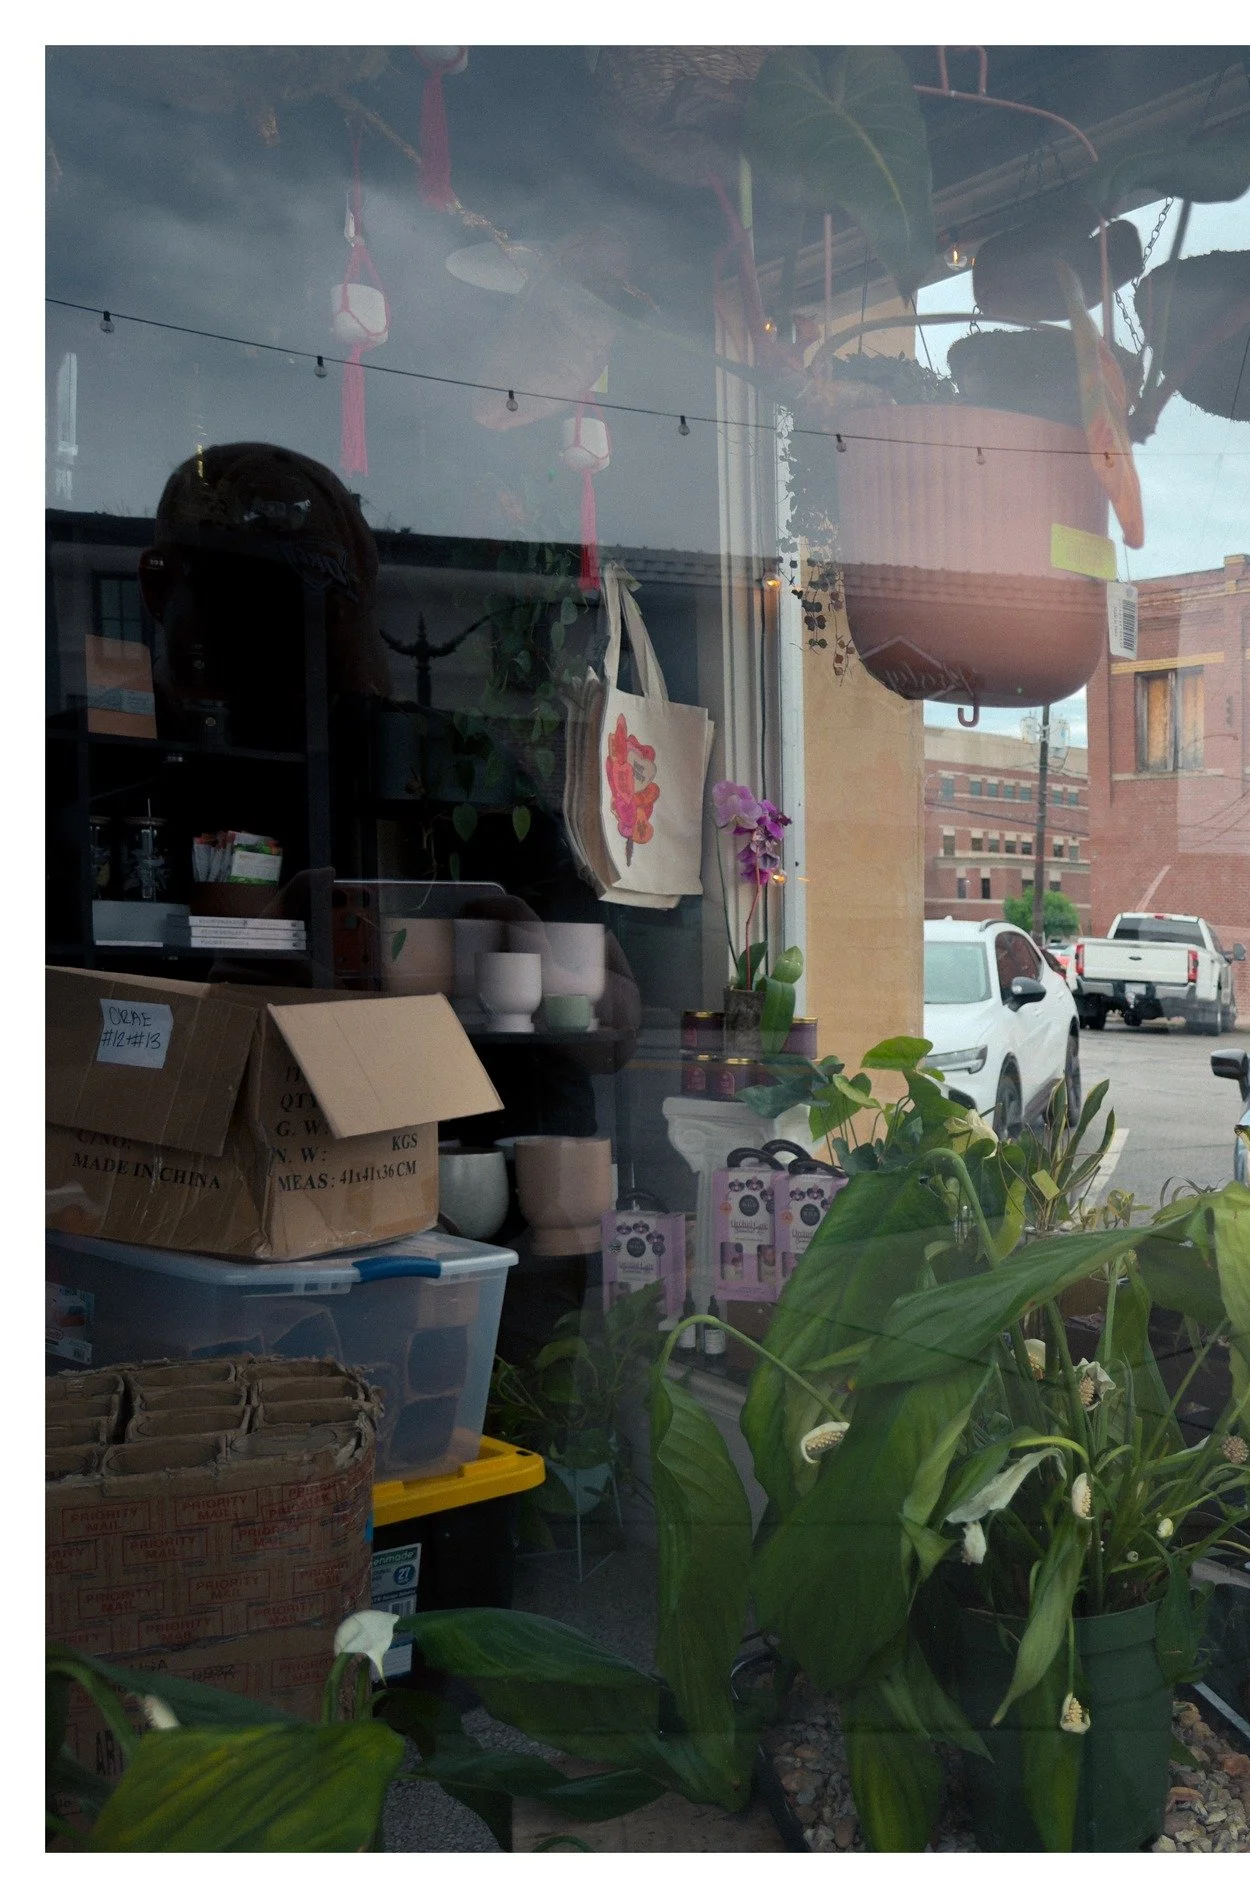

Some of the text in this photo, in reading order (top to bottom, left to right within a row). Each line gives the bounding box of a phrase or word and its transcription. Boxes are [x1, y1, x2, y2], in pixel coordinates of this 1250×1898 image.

[391, 1132, 418, 1151] KGS
[71, 1152, 221, 1190] MADE IN CHINA
[278, 1172, 336, 1192] MEAS:
[396, 1159, 417, 1176] CM
[182, 1495, 248, 1511] PRIORITY
[70, 1507, 139, 1523] PRIORITY
[197, 1509, 228, 1521] MAIL
[86, 1521, 118, 1533] MAIL
[130, 1536, 196, 1550] PRIORITY
[373, 1550, 414, 1567] enmade
[398, 1566, 411, 1580] 27
[196, 1576, 260, 1591] PRIORITY
[86, 1589, 153, 1604] PRIORITY
